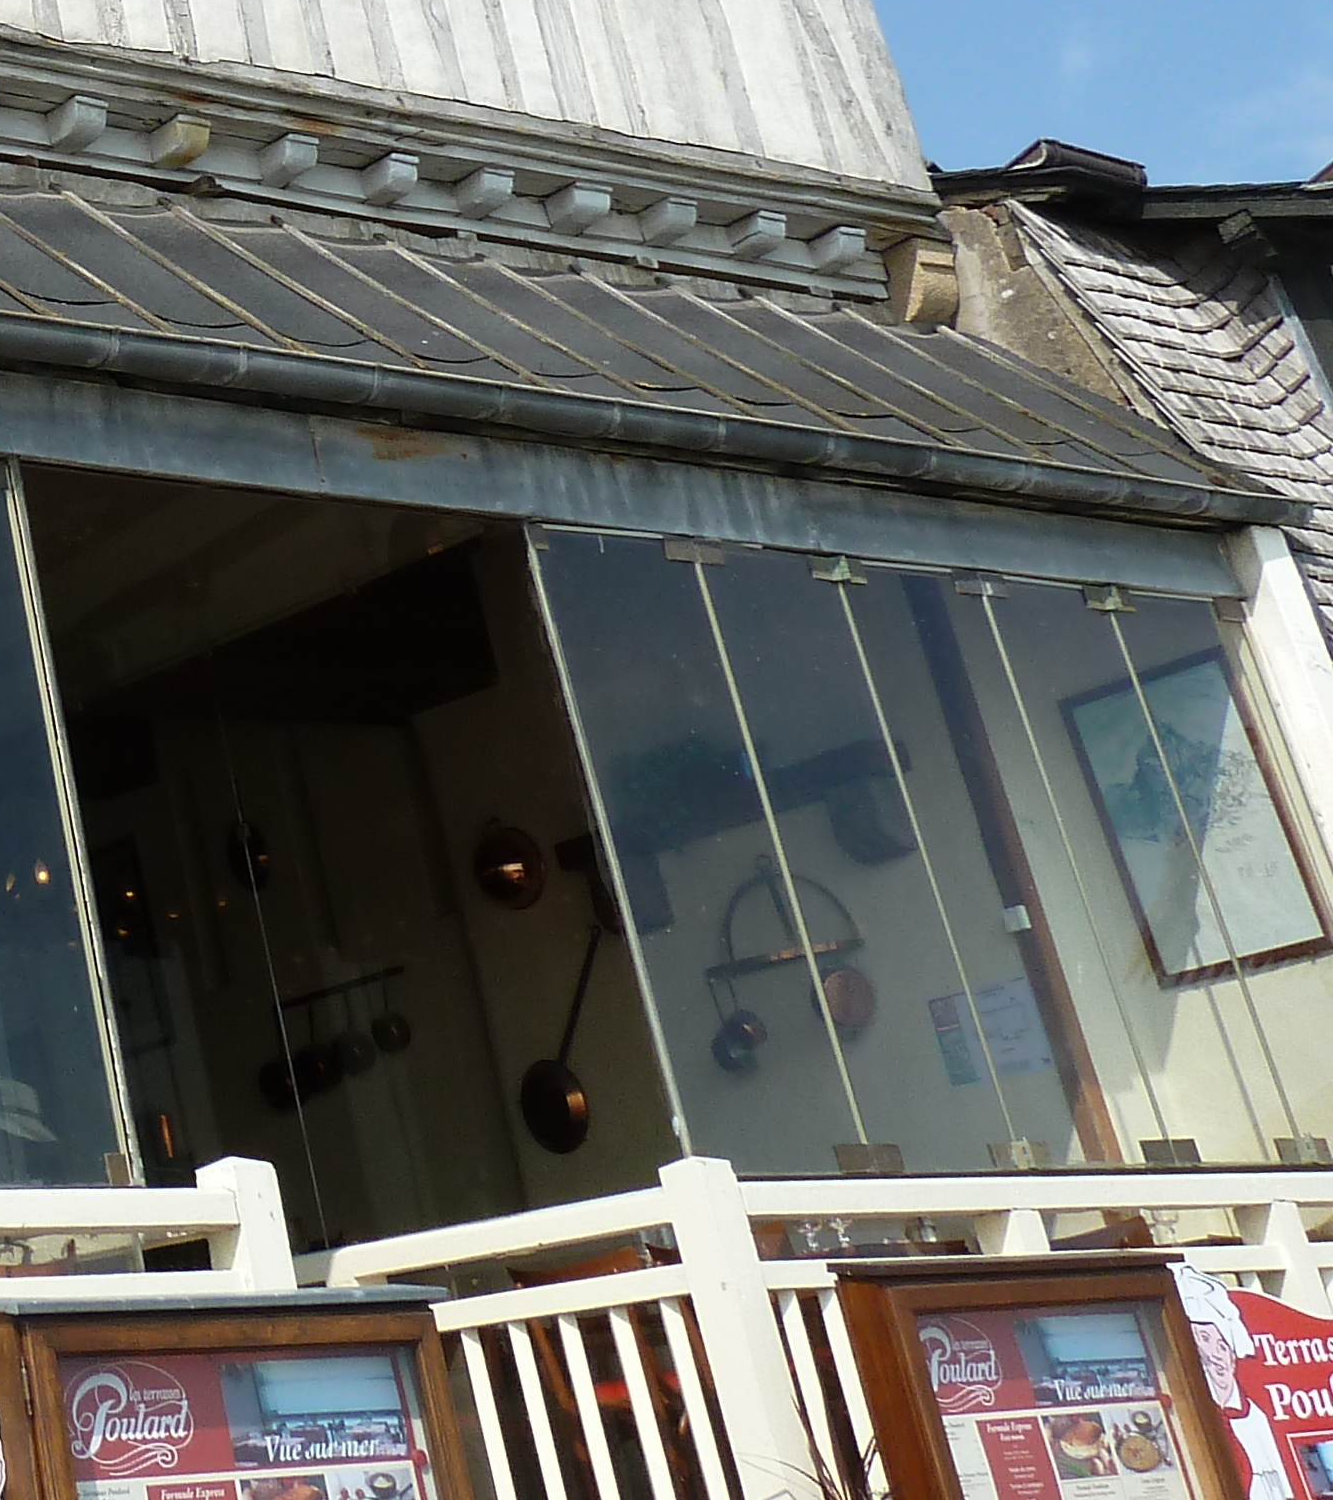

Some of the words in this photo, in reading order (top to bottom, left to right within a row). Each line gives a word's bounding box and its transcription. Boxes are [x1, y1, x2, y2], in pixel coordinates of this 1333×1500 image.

[919, 1327, 998, 1392] Poulard
[72, 1373, 188, 1458] Poulard
[264, 1435, 302, 1462] Vue
[304, 1440, 335, 1461] sur
[338, 1437, 380, 1457] mer
